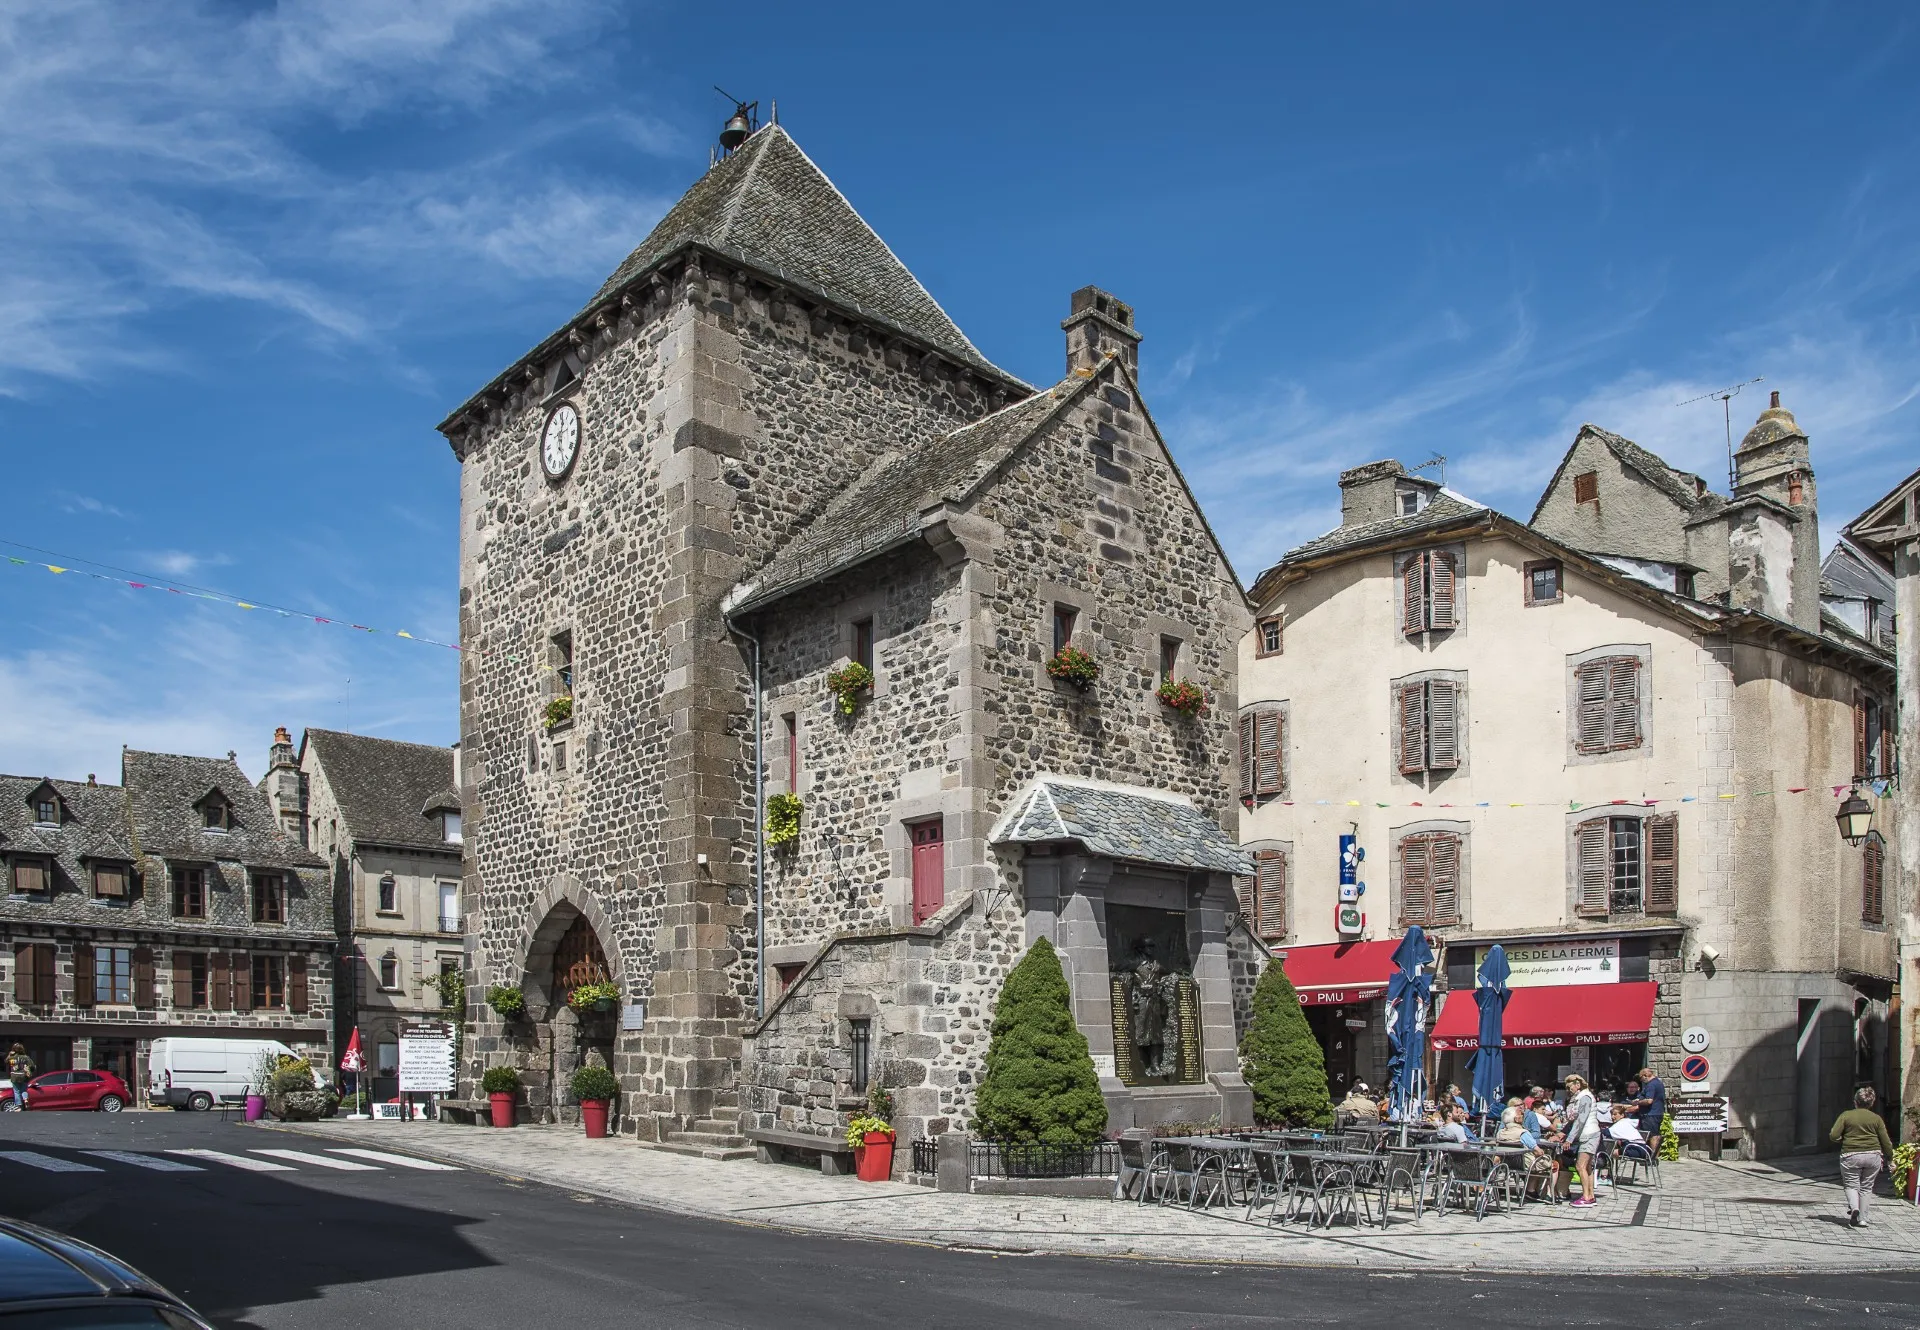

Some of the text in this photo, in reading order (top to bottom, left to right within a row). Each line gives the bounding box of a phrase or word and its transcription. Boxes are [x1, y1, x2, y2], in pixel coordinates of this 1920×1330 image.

[1482, 946, 1614, 961] GCES DE LA FERME
[1575, 965, 1592, 973] ferme
[1318, 992, 1344, 1002] PMU
[1456, 1039, 1478, 1048] BAR
[1514, 1037, 1562, 1046] Monaco
[1688, 1034, 1704, 1044] 20
